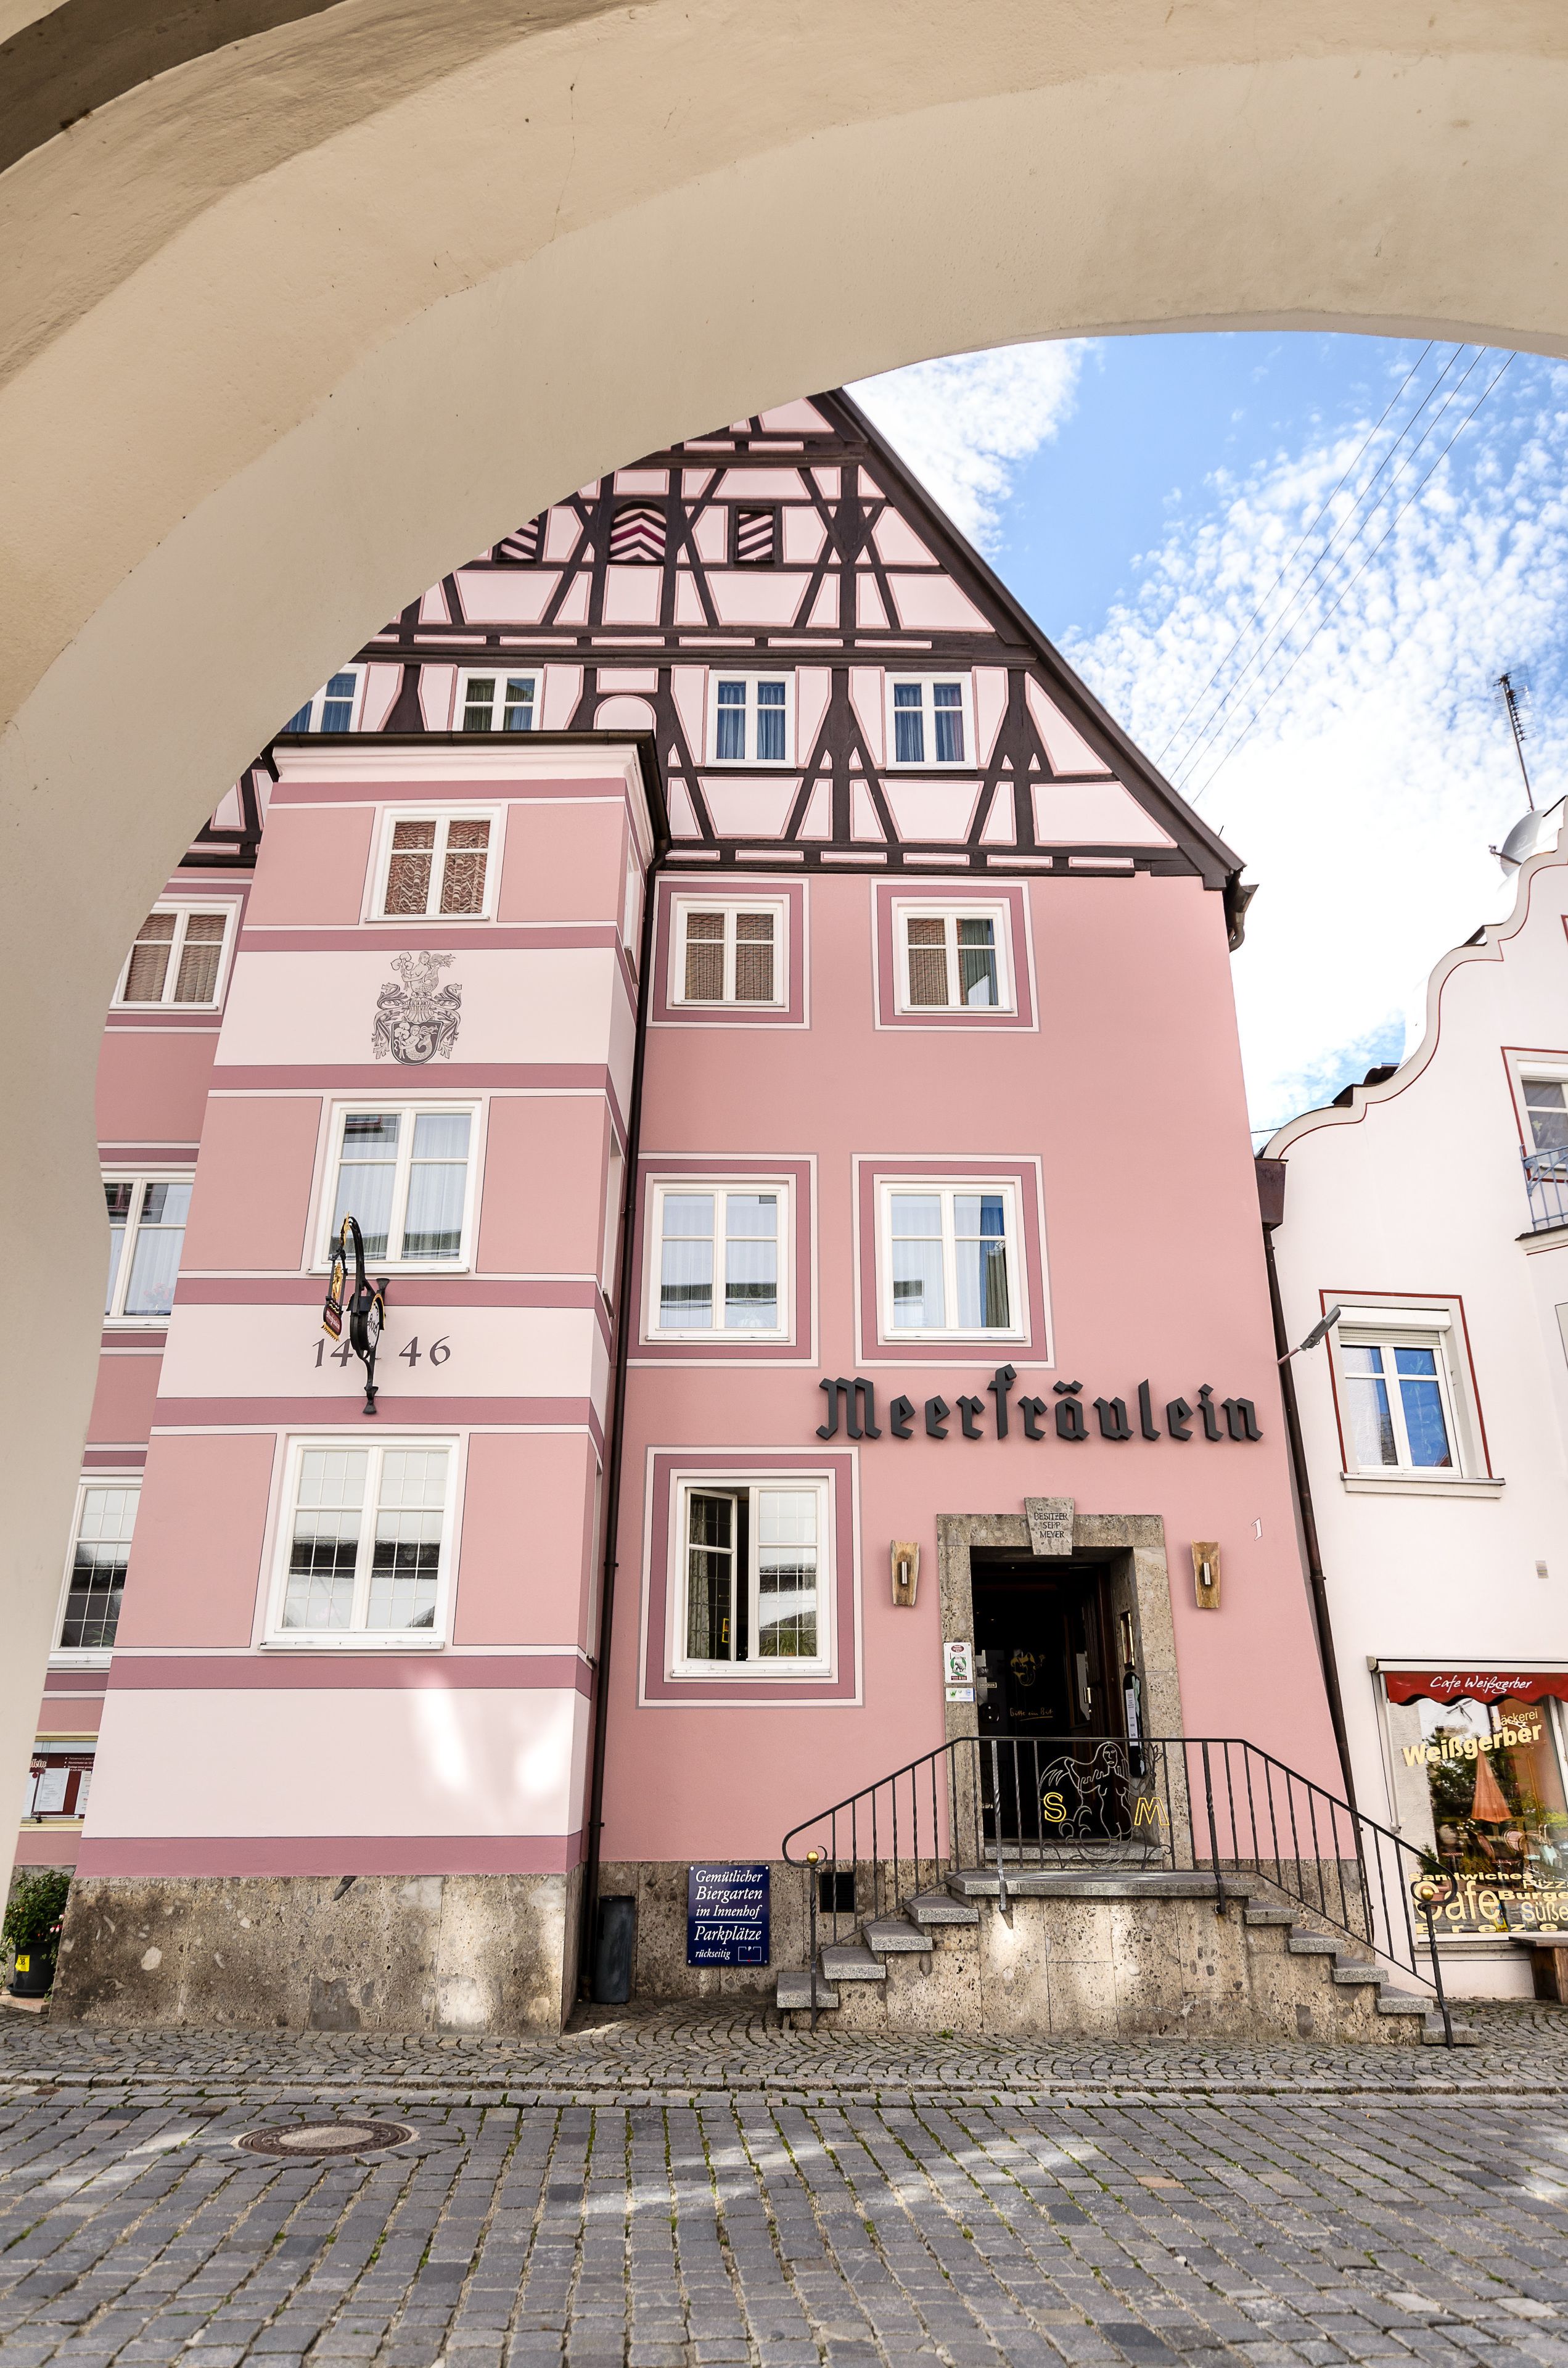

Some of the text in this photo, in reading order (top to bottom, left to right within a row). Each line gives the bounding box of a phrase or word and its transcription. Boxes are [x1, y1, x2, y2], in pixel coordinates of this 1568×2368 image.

[398, 1336, 451, 1367] 46
[816, 1363, 1263, 1442] Meerfräulein
[1033, 1512, 1069, 1521] BESITZER
[1043, 1521, 1061, 1529] SEPP
[1040, 1531, 1065, 1539] MEYER
[1250, 1517, 1263, 1542] 1
[1430, 1675, 1533, 1694] Cafe Weißgerber
[1402, 1723, 1542, 1767] Weißgerber
[1043, 1792, 1170, 1826] S M
[696, 1870, 763, 1882] Gemütlicher
[1522, 1879, 1568, 1889] Pizz
[696, 1886, 763, 1903] Biergarten
[1414, 1880, 1500, 1920] Cafe
[696, 1904, 762, 1920] im Innenhof
[694, 1925, 761, 1944] Parkplätze
[695, 1948, 731, 1960] rückseitig
